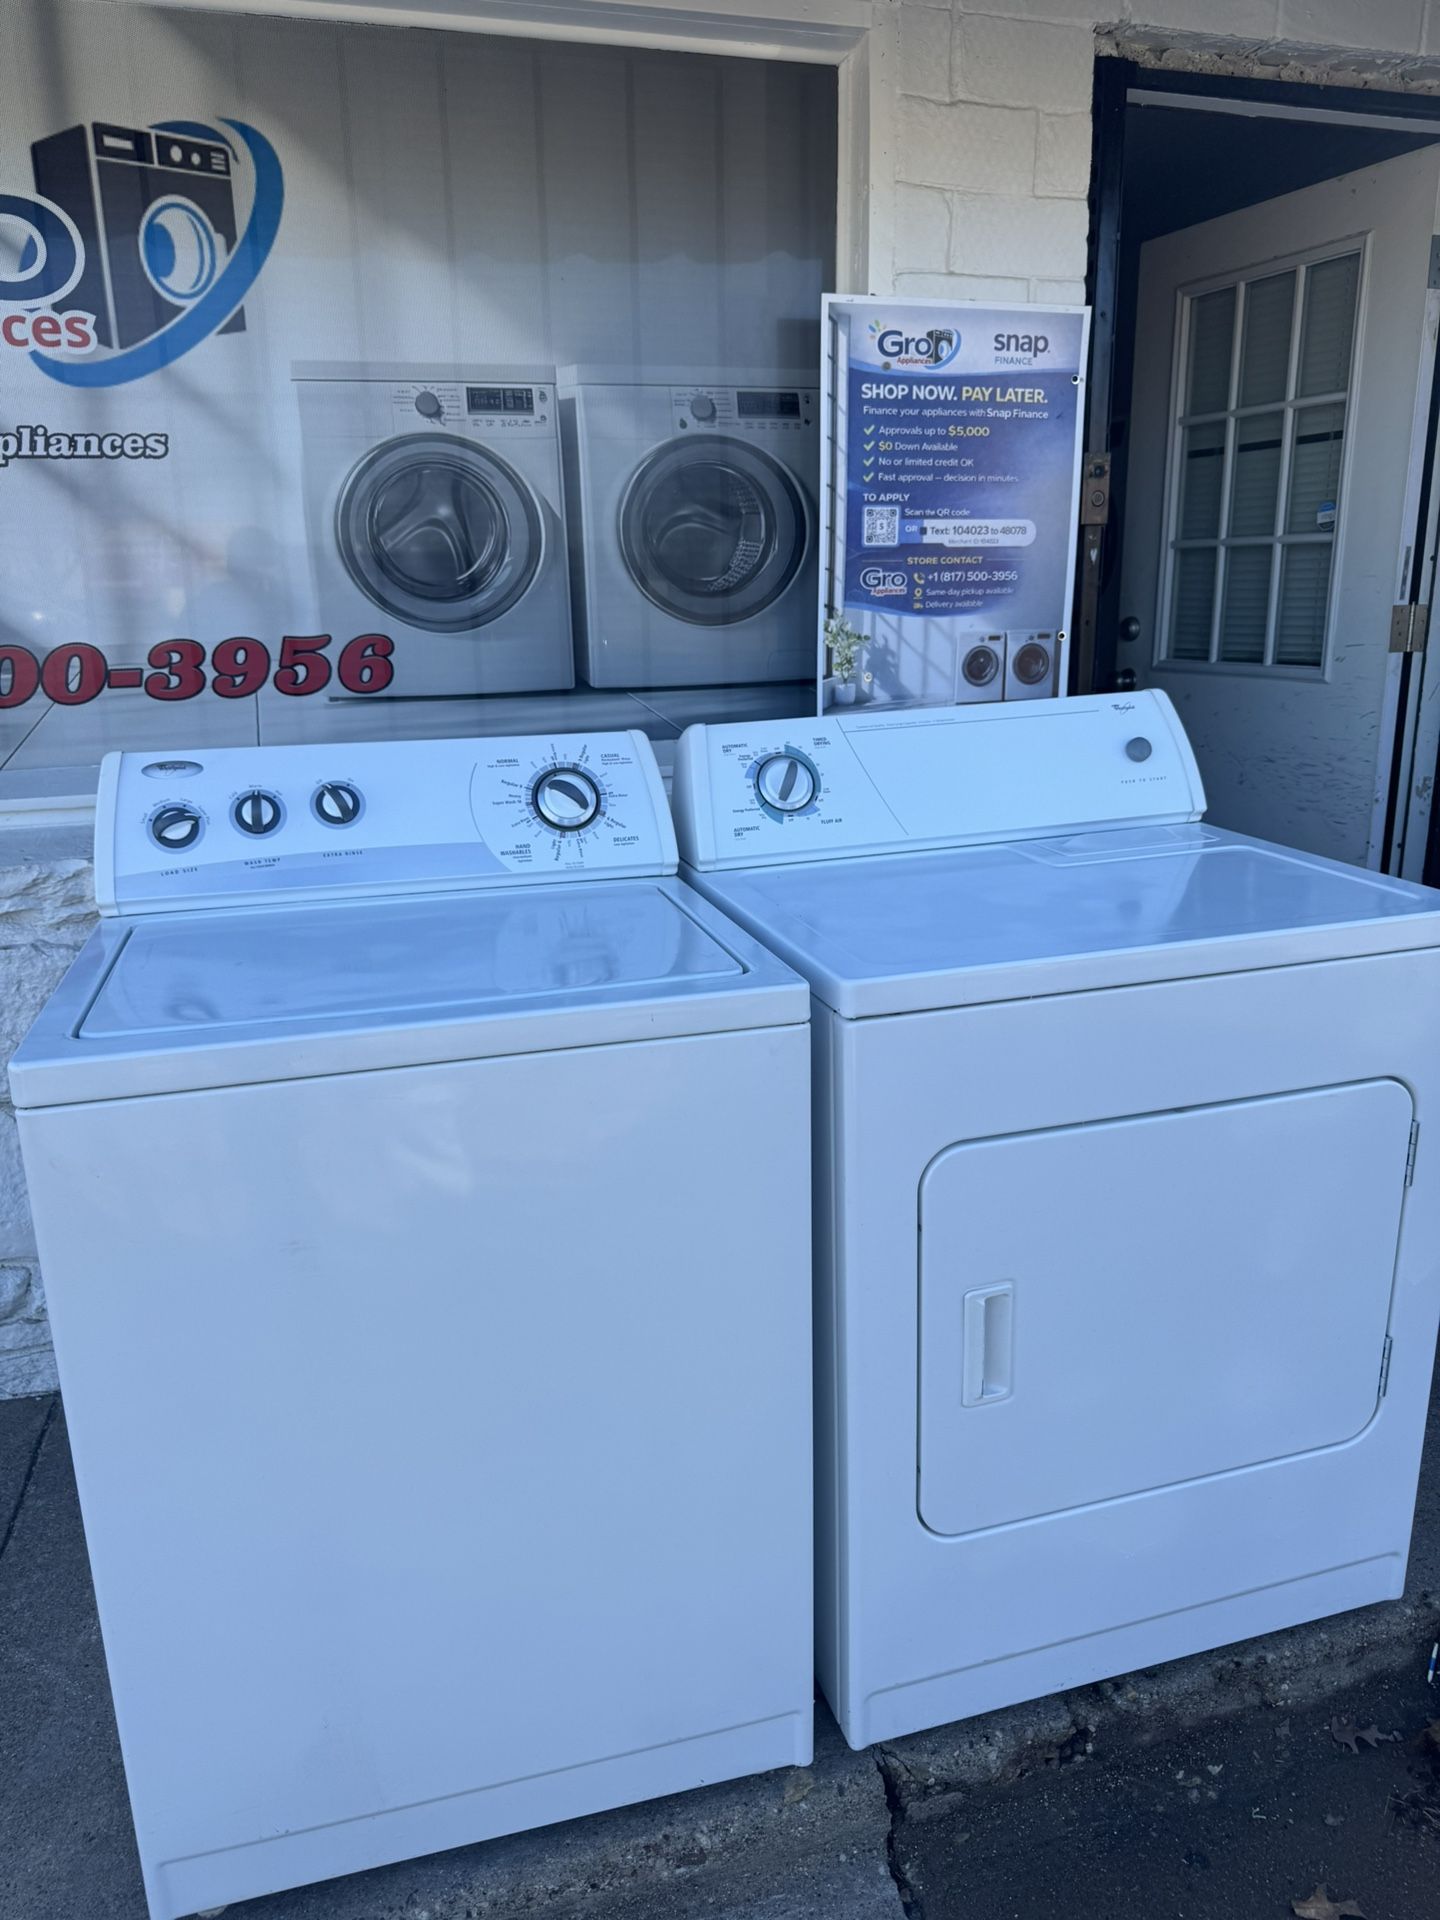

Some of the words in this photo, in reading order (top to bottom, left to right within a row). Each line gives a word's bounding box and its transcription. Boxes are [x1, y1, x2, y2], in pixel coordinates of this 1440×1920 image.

[877, 330, 932, 358] Gro
[897, 356, 932, 366] Appliances
[994, 357, 1033, 366] FINANCE
[861, 383, 909, 400] SHOP
[912, 385, 957, 401] NOW.
[962, 386, 993, 401] PAY
[996, 388, 1048, 403] LATER.
[863, 406, 898, 416] Finance
[900, 408, 920, 418] your
[922, 407, 967, 418] appliances
[969, 408, 986, 417] with
[987, 408, 1012, 420] Snap
[1013, 409, 1049, 419] Finance
[878, 425, 922, 436] Approvals
[924, 427, 935, 436] up
[937, 427, 946, 436] to
[948, 425, 990, 437] $5,000
[878, 441, 893, 451] $0
[895, 442, 920, 451] Down
[922, 442, 958, 452] Available
[878, 457, 892, 466] No
[893, 458, 903, 466] or
[904, 457, 933, 467] limited
[935, 457, 959, 467] credit
[960, 458, 974, 467] OK
[878, 472, 896, 482] Fast
[898, 473, 934, 484] approval
[943, 473, 976, 483] decision
[977, 474, 986, 482] in
[987, 474, 1018, 483] minutes
[863, 493, 877, 502] TO
[878, 493, 911, 502] APPLY
[904, 508, 924, 516] Scan
[925, 508, 936, 516] the
[937, 508, 950, 517] QR
[951, 508, 971, 516] code
[904, 525, 918, 534] OR
[930, 526, 950, 535] Text:
[952, 525, 990, 535] 104023
[991, 526, 999, 535] to
[999, 526, 1028, 535] 48078
[906, 556, 939, 566] STORE
[940, 556, 984, 565] CONTACT
[860, 567, 908, 589] Gro
[927, 572, 939, 582] +1
[940, 571, 966, 582] (817)
[967, 570, 1018, 582] 500-3956
[925, 588, 960, 597] Same-day
[961, 587, 985, 597] pickup
[925, 600, 953, 609] Delivery
[954, 600, 983, 608] available
